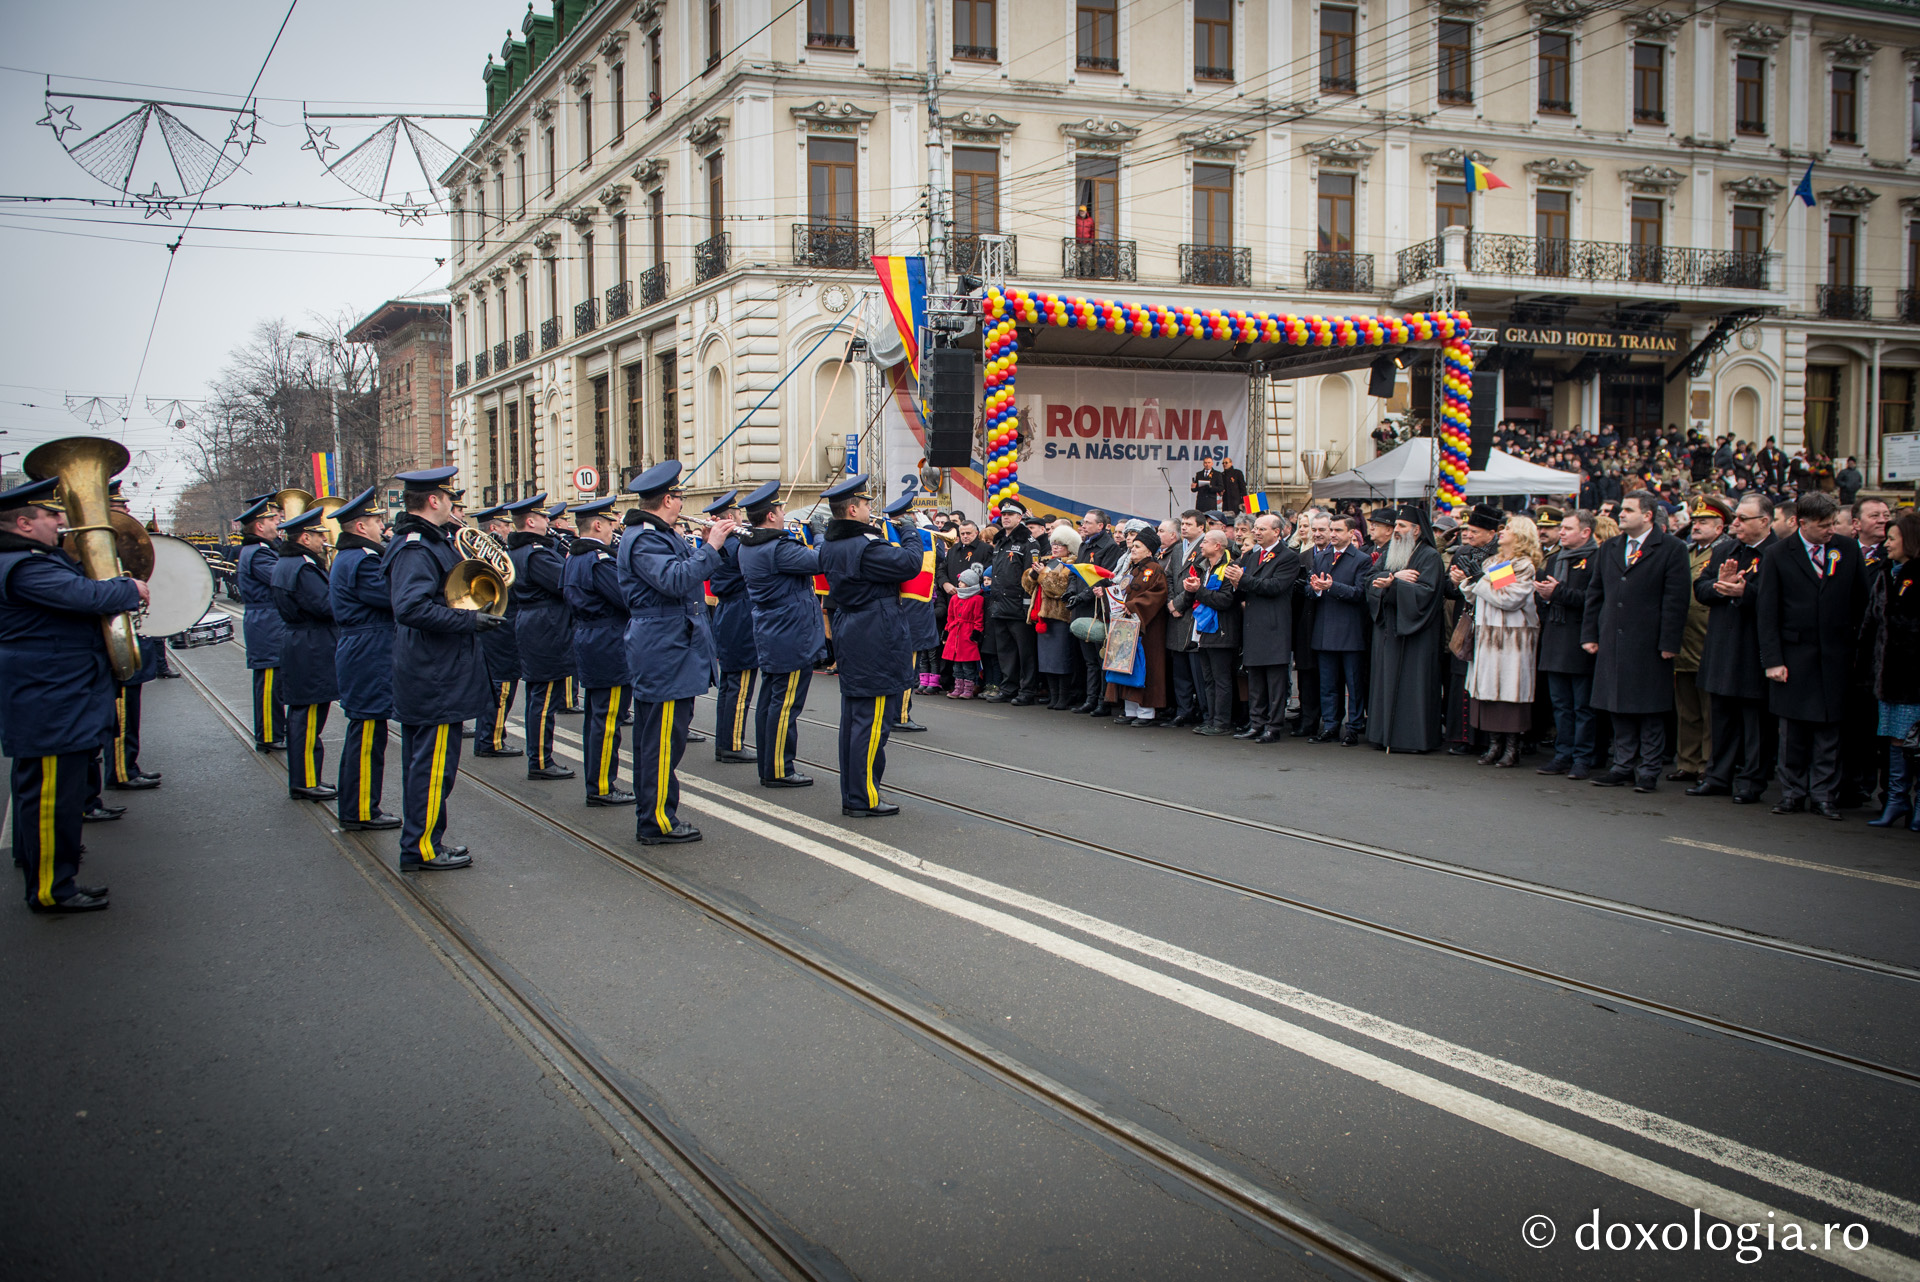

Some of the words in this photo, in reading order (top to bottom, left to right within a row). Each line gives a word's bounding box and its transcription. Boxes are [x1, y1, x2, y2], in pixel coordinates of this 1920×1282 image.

[1505, 327, 1561, 345] GRAND
[1566, 331, 1616, 348] HOTEL
[1619, 334, 1677, 351] TRAIAN
[1046, 397, 1229, 441] ROMÂNIA
[1044, 442, 1081, 460] S-A
[1085, 439, 1162, 461] NĂSCUT
[1166, 445, 1190, 461] LA
[1193, 446, 1229, 467] IAȘI
[581, 472, 592, 485] 10
[912, 499, 938, 507] NUARIE
